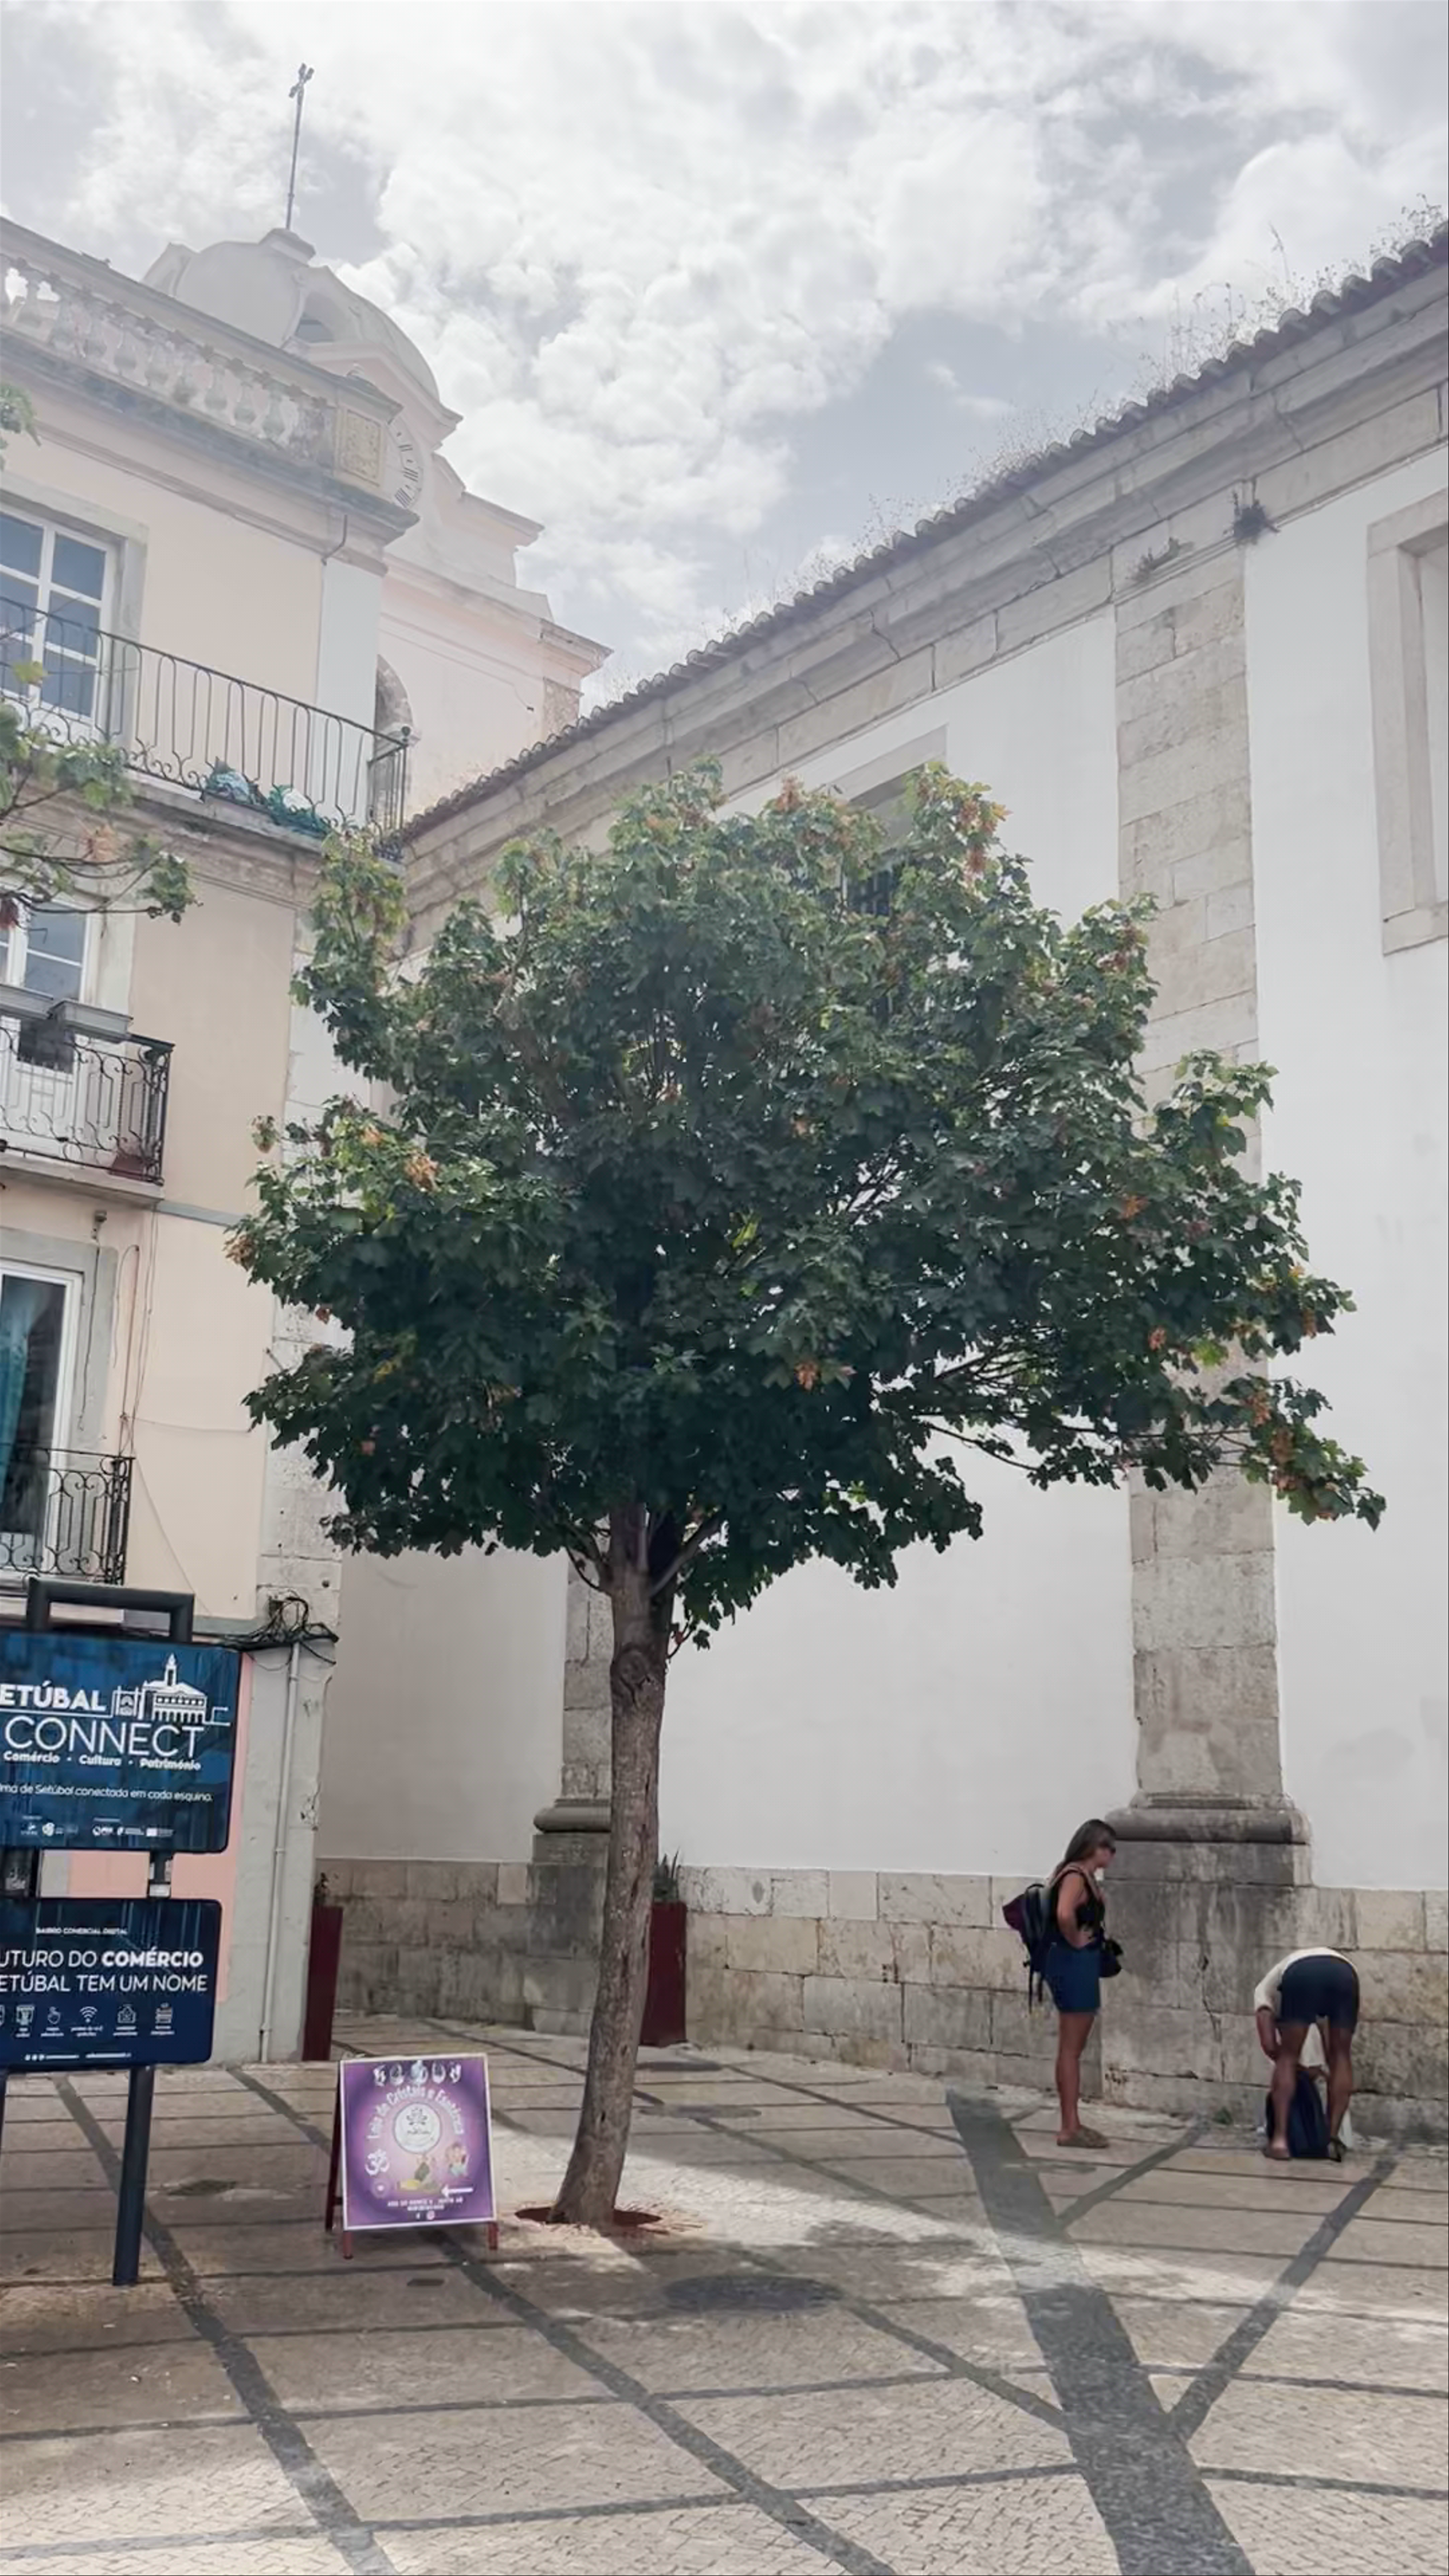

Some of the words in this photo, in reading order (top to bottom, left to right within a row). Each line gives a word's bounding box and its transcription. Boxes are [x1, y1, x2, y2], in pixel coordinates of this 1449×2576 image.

[5, 1716, 204, 1758] CONNECT
[3, 1751, 60, 1763] Comércio
[79, 1755, 122, 1766] Cultura
[19, 1782, 33, 1794] de
[35, 1784, 74, 1795] Setúbal
[75, 1787, 128, 1798] conectada
[148, 1789, 172, 1800] cada
[68, 1950, 97, 1967] DO
[102, 1946, 204, 1967] COMÉRCIO
[76, 1975, 115, 1992] TEM
[120, 1975, 149, 1992] UM
[152, 1974, 208, 1992] NOME
